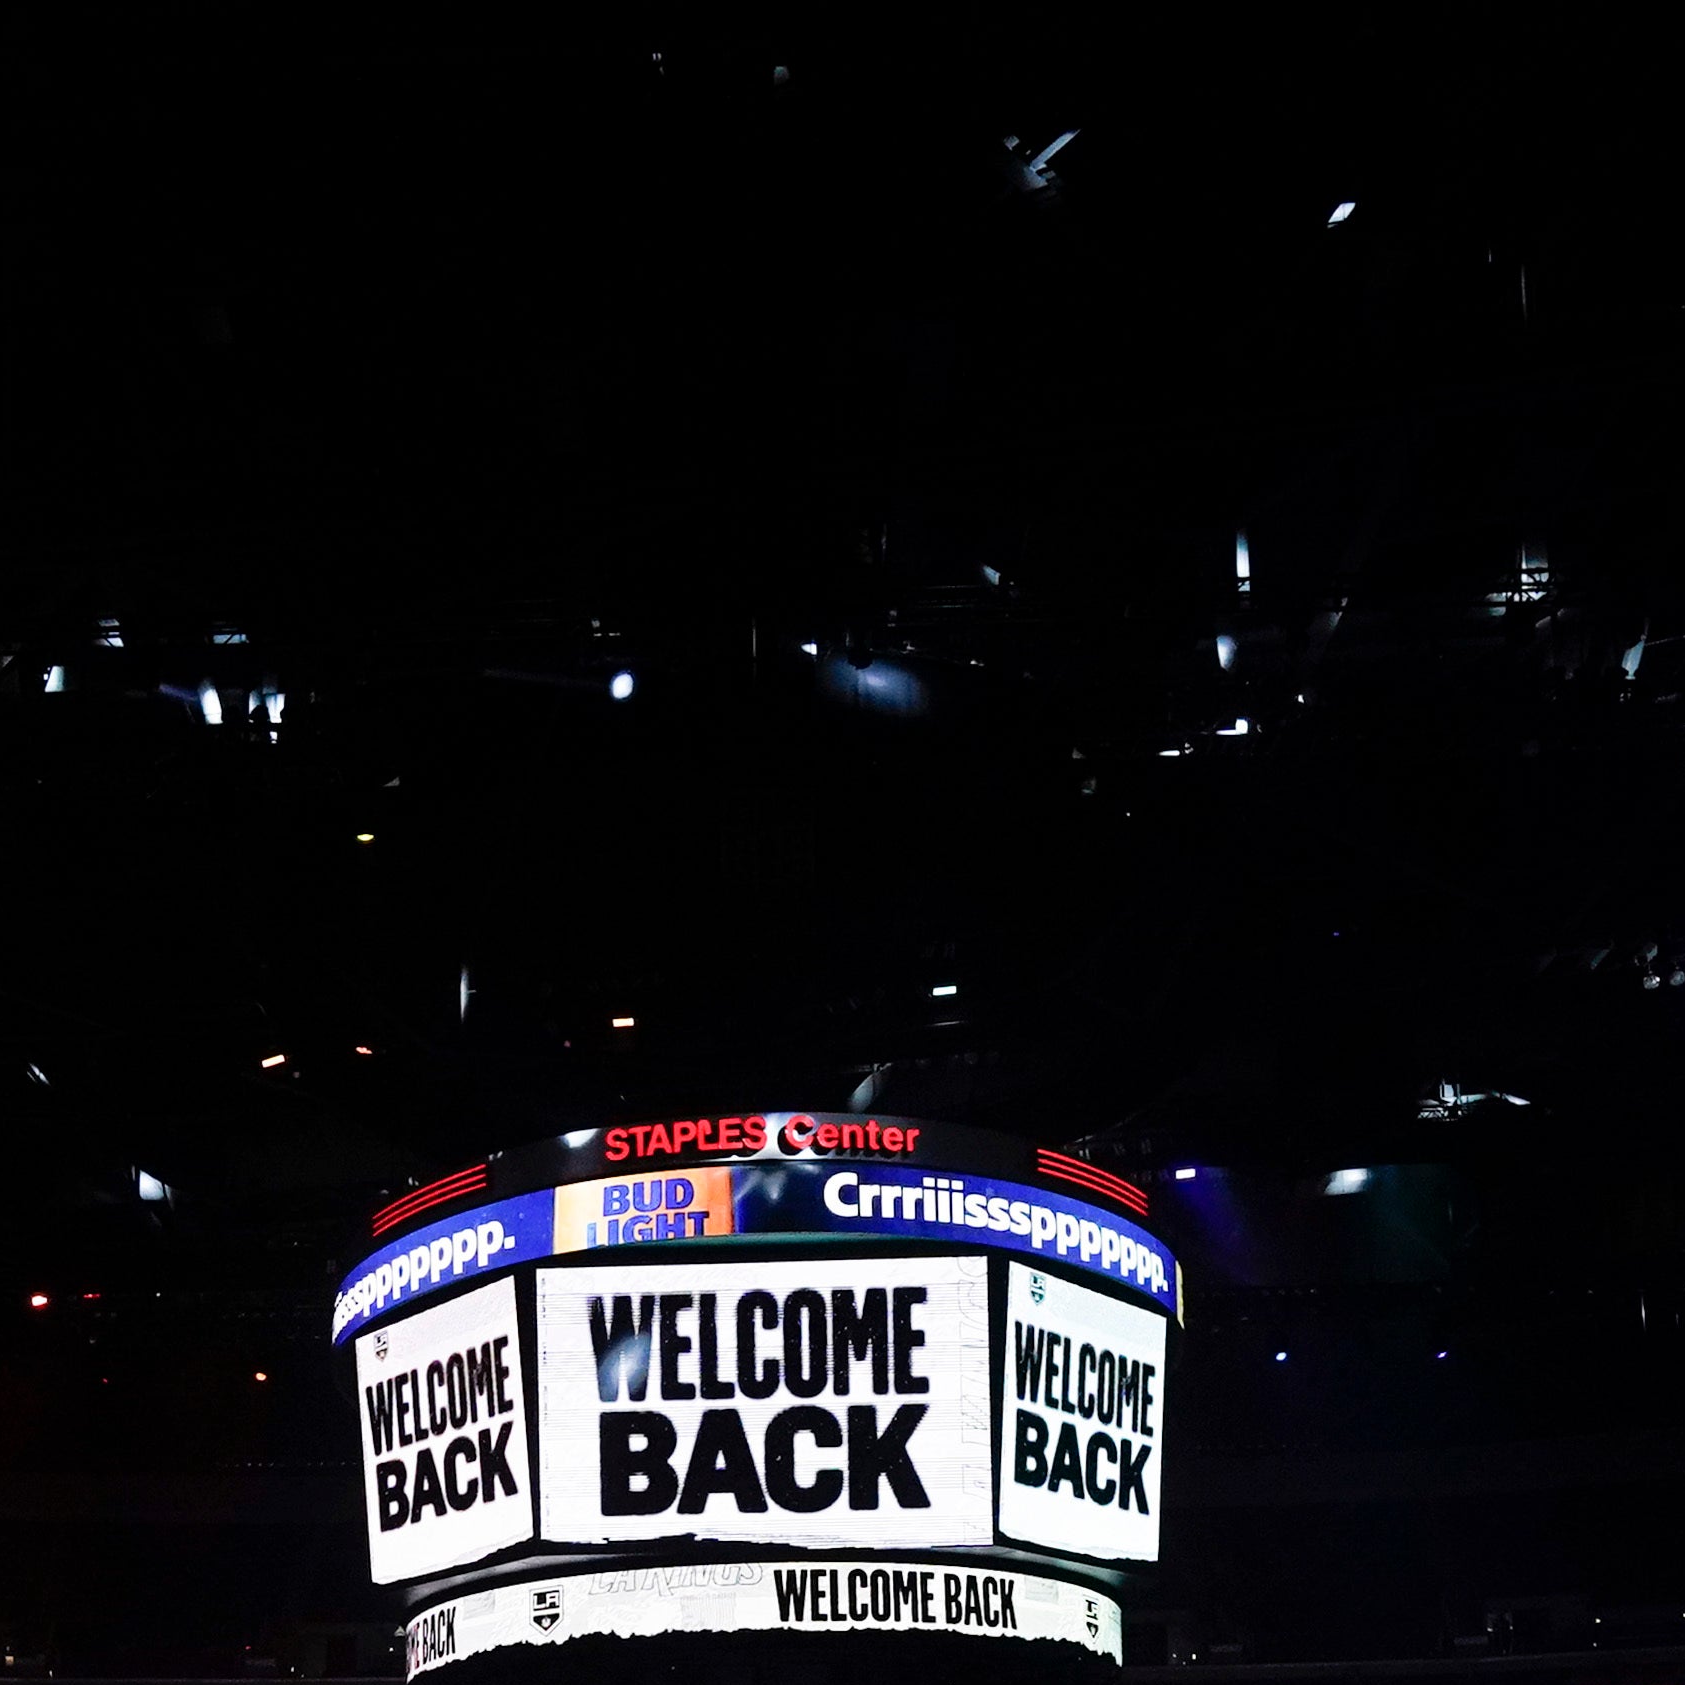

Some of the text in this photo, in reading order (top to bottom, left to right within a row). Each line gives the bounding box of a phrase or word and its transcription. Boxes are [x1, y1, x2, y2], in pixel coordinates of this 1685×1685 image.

[605, 1113, 919, 1162] STAPLES Center
[586, 1210, 710, 1249] LIGHT
[602, 1177, 695, 1217] BUD
[365, 1334, 514, 1457] WELCOME
[588, 1287, 930, 1401] WELCOME
[1012, 1320, 1156, 1441] WELCOME
[376, 1420, 519, 1533] BACK
[600, 1403, 931, 1517] BACK
[1012, 1410, 1153, 1517] BACK
[422, 1605, 456, 1665] BACK
[773, 1570, 1017, 1632] WELCOME BACK
